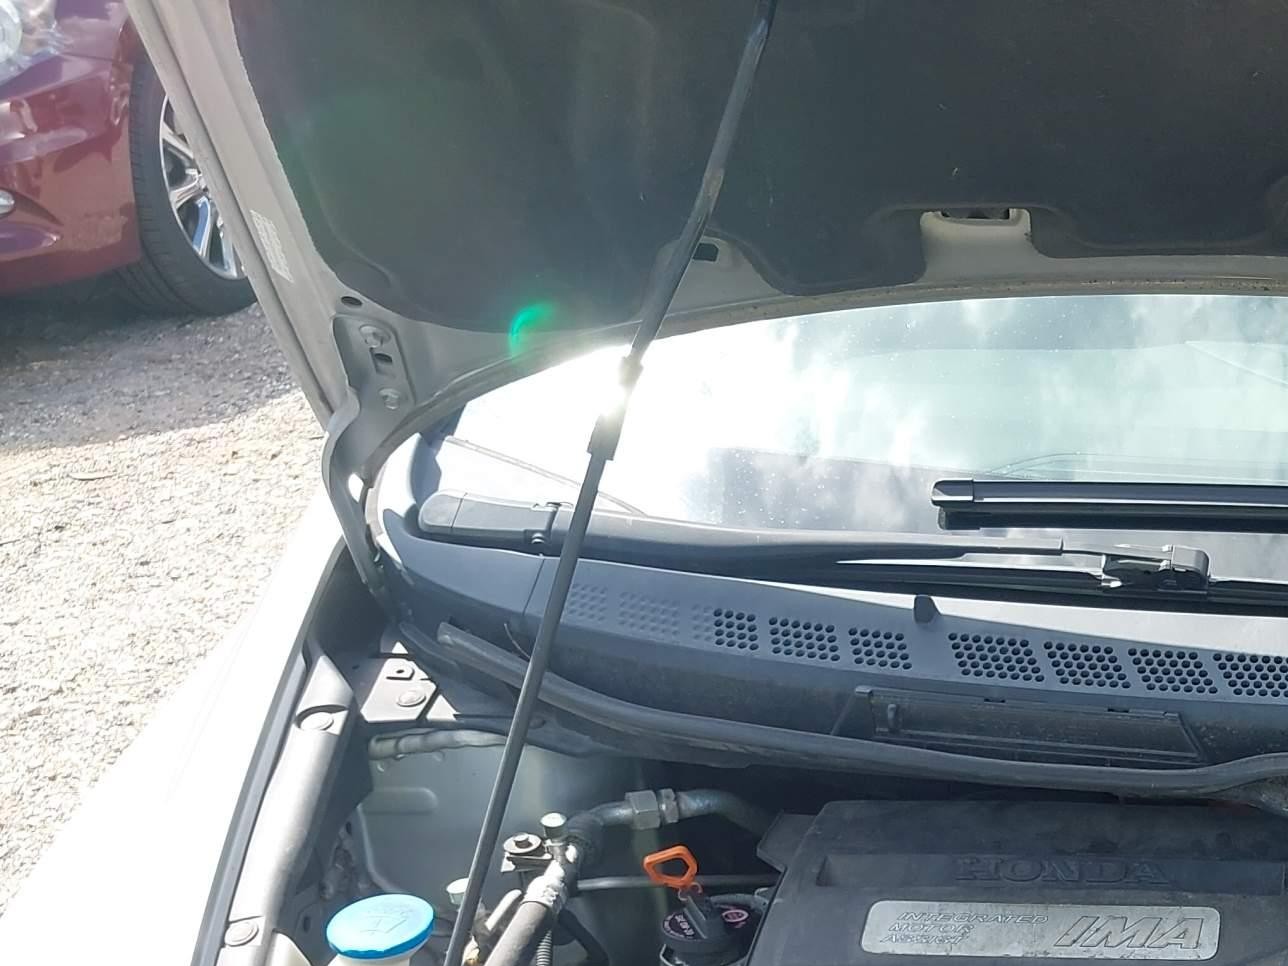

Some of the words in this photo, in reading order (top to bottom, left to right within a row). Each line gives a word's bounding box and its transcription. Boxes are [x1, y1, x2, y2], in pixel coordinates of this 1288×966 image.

[955, 857, 1169, 884] HONDA
[897, 912, 1049, 924] INTEGRATED
[888, 922, 974, 934] MOTOR
[1053, 915, 1205, 950] IMA
[880, 934, 965, 945] ASSIST
